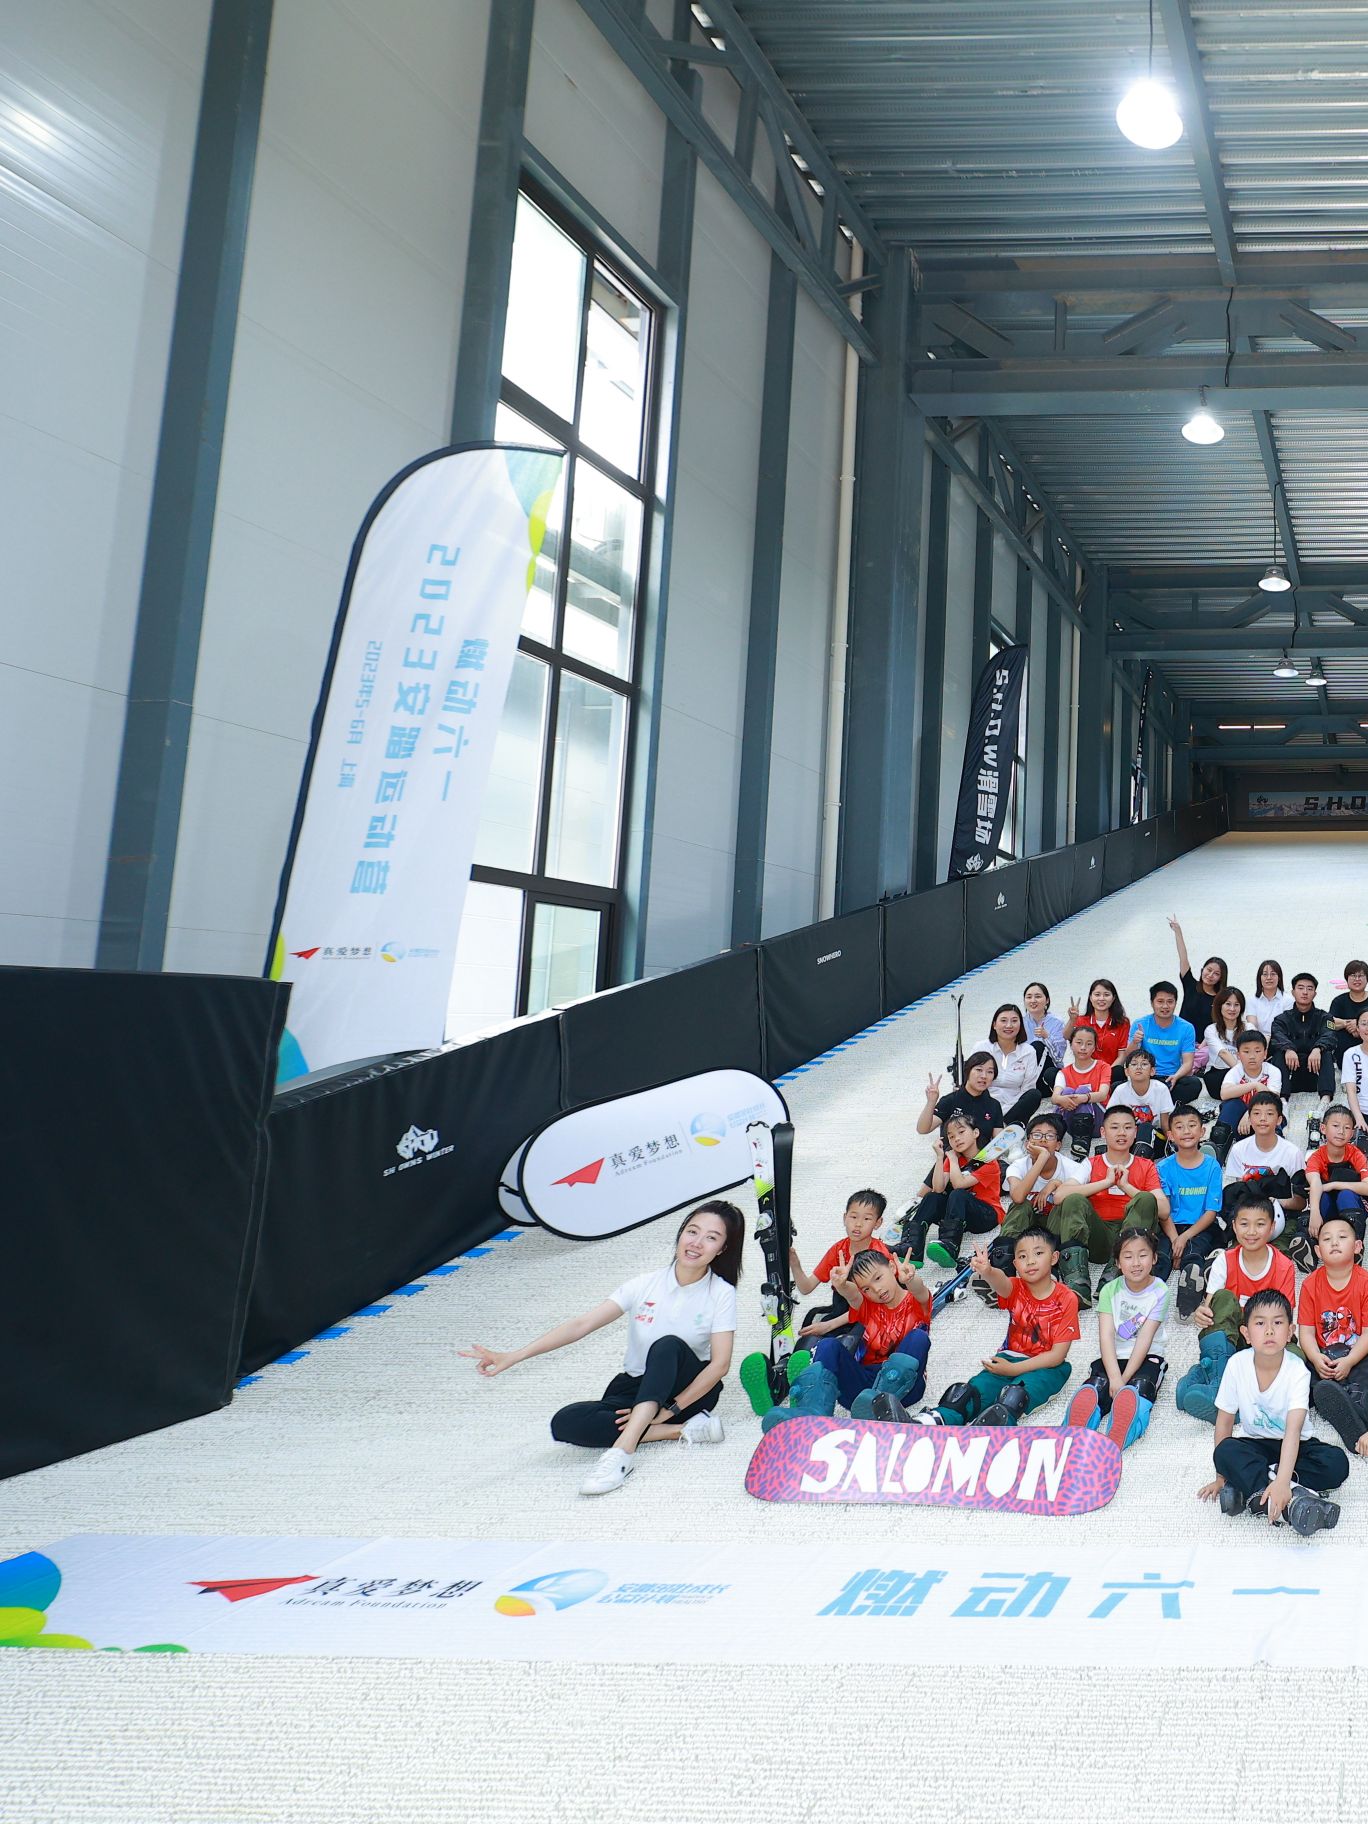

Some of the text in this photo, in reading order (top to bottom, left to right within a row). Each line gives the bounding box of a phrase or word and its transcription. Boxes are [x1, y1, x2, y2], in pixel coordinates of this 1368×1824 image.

[349, 543, 461, 895] 2023安踏运动营
[432, 637, 490, 801] 燃动六一
[323, 946, 373, 956] 真爱梦想
[608, 1132, 681, 1169] 真爱梦想
[799, 1429, 1074, 1502] SALOMON
[278, 1597, 449, 1610] Adream Foundation
[300, 1576, 484, 1599] 真爱梦想
